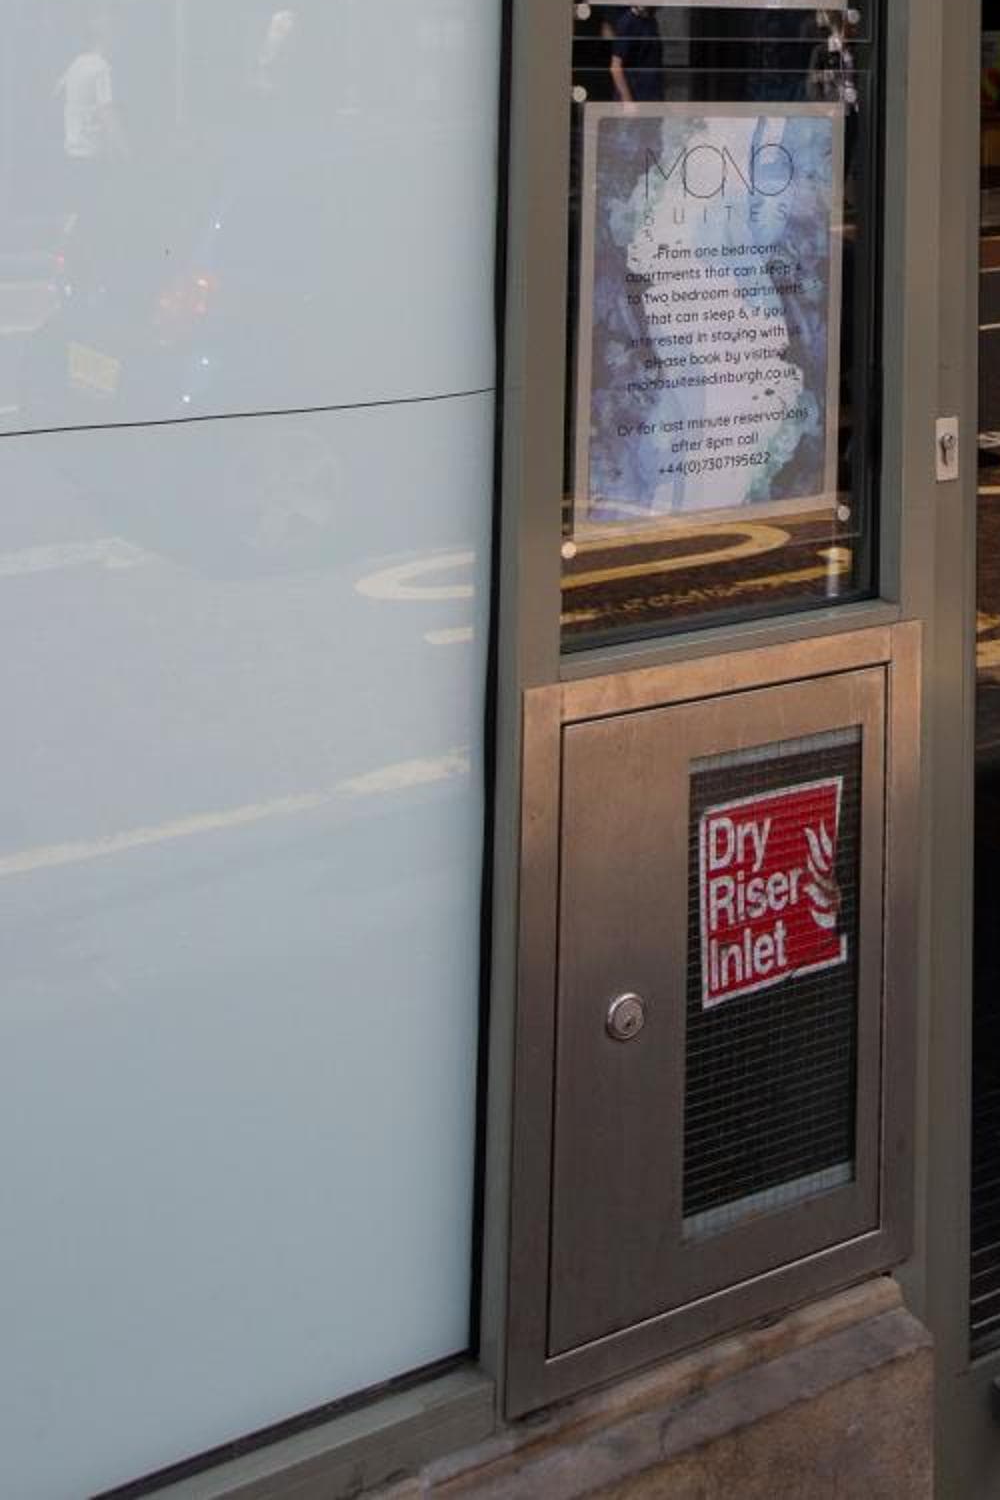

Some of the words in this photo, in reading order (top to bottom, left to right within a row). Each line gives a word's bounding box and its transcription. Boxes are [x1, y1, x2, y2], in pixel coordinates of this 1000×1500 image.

[645, 144, 794, 199] MONO
[644, 203, 787, 226] SUITES
[657, 244, 691, 260] From
[695, 247, 719, 259] one
[721, 244, 778, 257] bedroom
[625, 268, 701, 284] apartments
[704, 266, 730, 279] that
[733, 265, 757, 277] can
[642, 293, 669, 304] two
[671, 288, 729, 303] bedroom
[733, 282, 804, 298] apartments
[644, 311, 672, 326] that
[675, 312, 699, 324] can
[703, 308, 735, 323] sleep
[751, 306, 761, 317] if
[763, 306, 788, 321] you
[697, 332, 709, 343] in
[711, 327, 757, 343] staying
[760, 325, 785, 338] with
[645, 355, 686, 371] please
[689, 350, 720, 365] book
[725, 349, 741, 365] by
[743, 347, 787, 362] visiting
[637, 420, 657, 436] for
[687, 415, 731, 430] minute
[734, 407, 809, 425] reservations
[671, 438, 701, 454] after
[737, 431, 759, 446] call
[709, 817, 772, 873] Dry
[709, 865, 802, 931] Riser
[710, 919, 788, 991] Inlet
